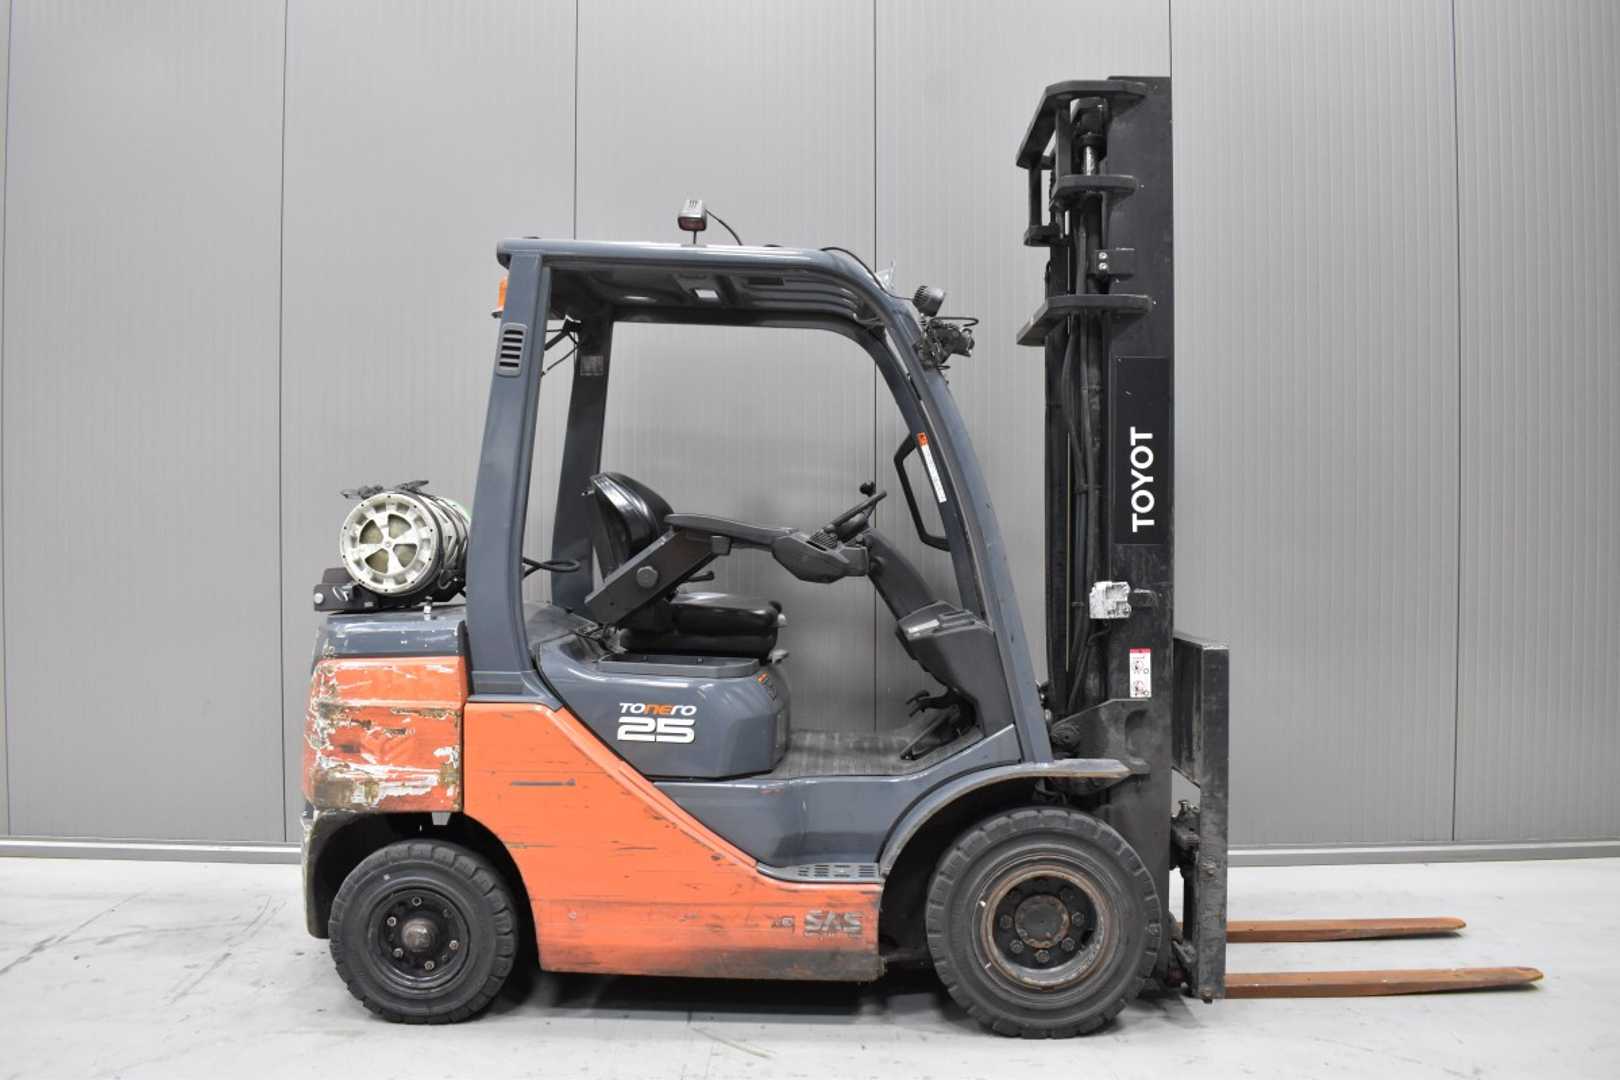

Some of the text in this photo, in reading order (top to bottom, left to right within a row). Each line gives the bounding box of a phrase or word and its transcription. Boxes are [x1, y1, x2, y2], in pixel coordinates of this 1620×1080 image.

[1130, 426, 1155, 533] TOYOT
[617, 715, 696, 744] 25
[804, 909, 864, 933] SAS
